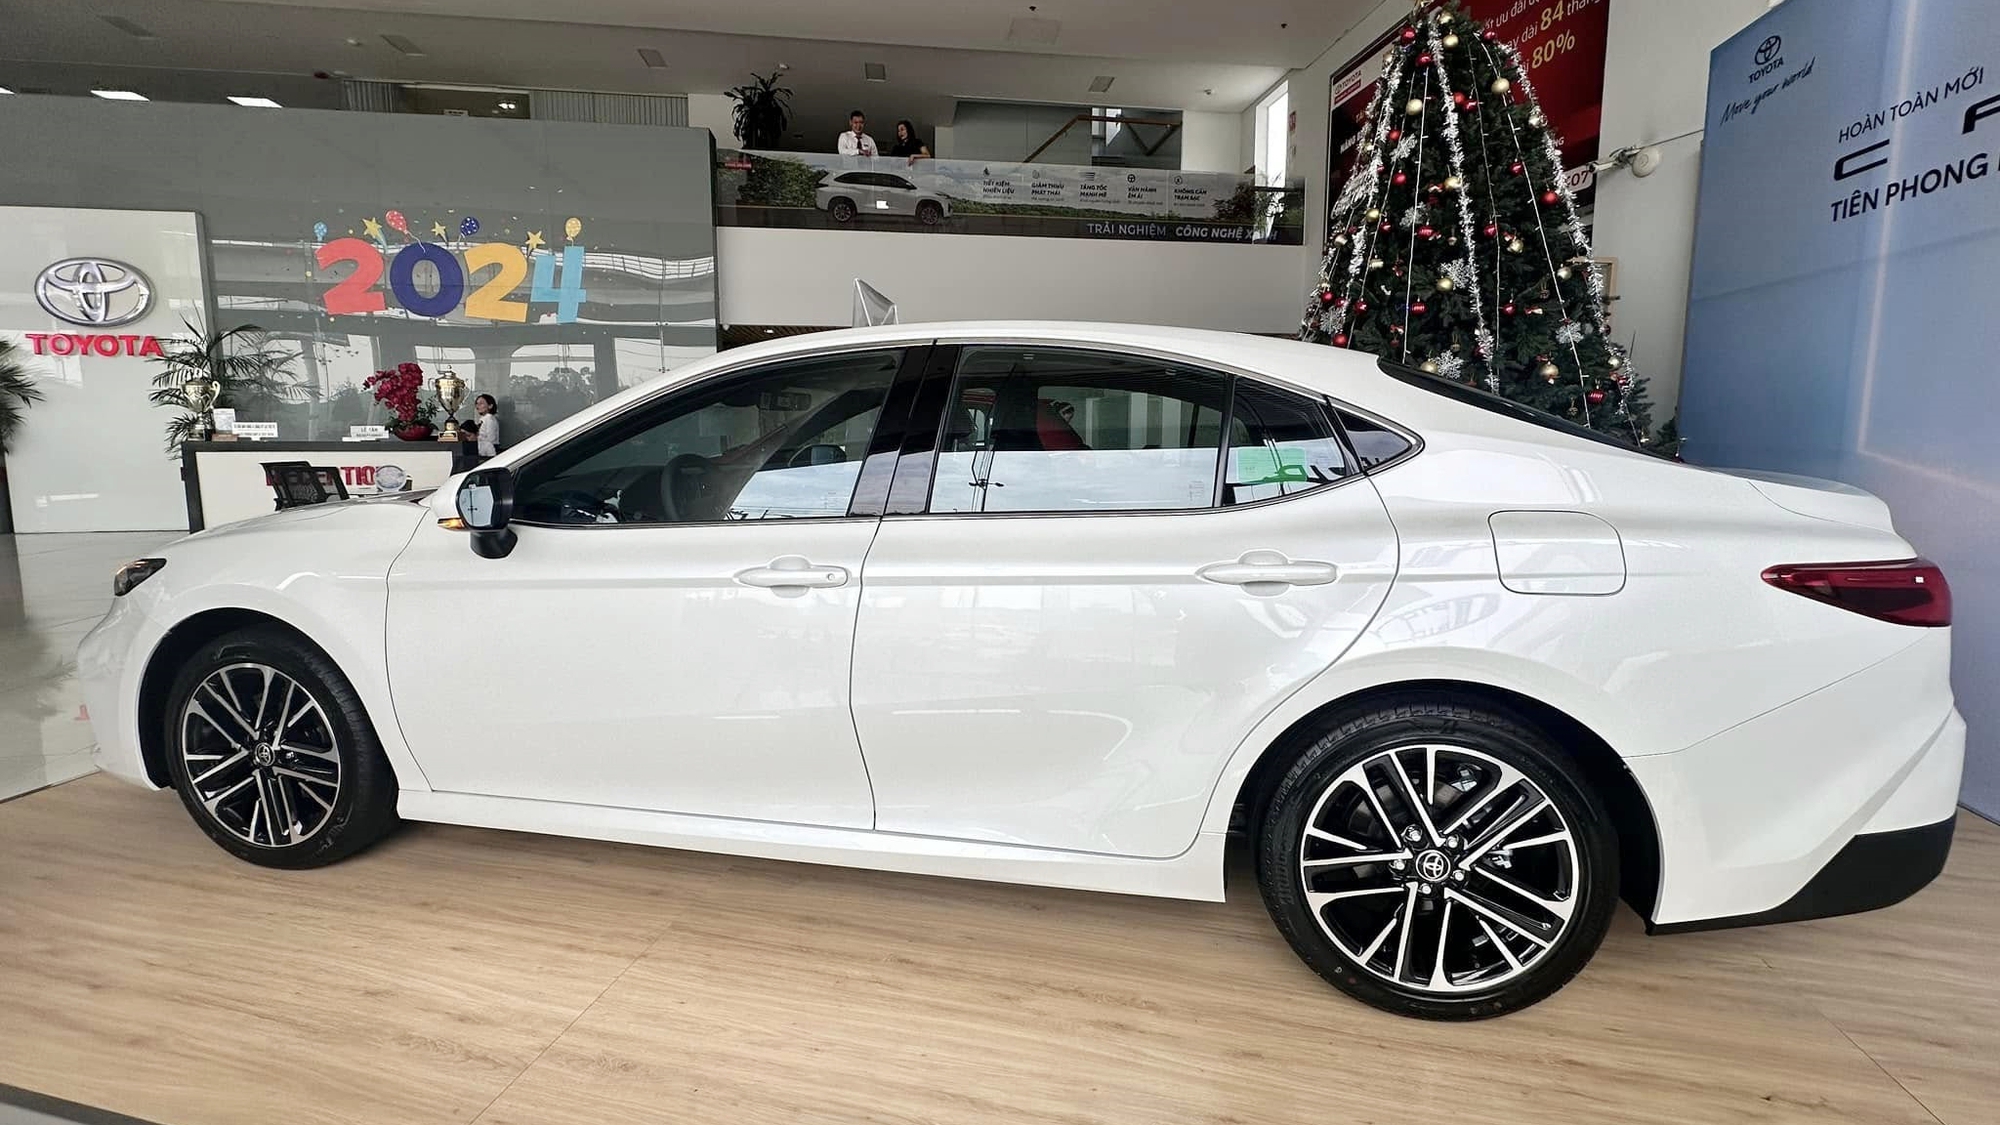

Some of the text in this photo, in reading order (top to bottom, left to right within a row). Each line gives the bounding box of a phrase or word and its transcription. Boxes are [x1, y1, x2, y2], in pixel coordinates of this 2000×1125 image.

[1521, 21, 1538, 43] dài
[1540, 1, 1564, 31] 84
[1532, 29, 1575, 69] 80%
[1748, 57, 1784, 84] TOYOTA
[1838, 66, 1984, 144] HOÀN TOÀN MỚI
[1565, 170, 1589, 187] 07
[1831, 153, 1989, 222] TIÊN PHONG
[1087, 221, 1114, 235] TRẢI
[1118, 224, 1166, 238] NGHIỆM
[1175, 225, 1209, 238] CÔNG
[1210, 227, 1243, 241] NGHỆ
[315, 237, 586, 324] 2024
[25, 333, 165, 357] TOYOTA
